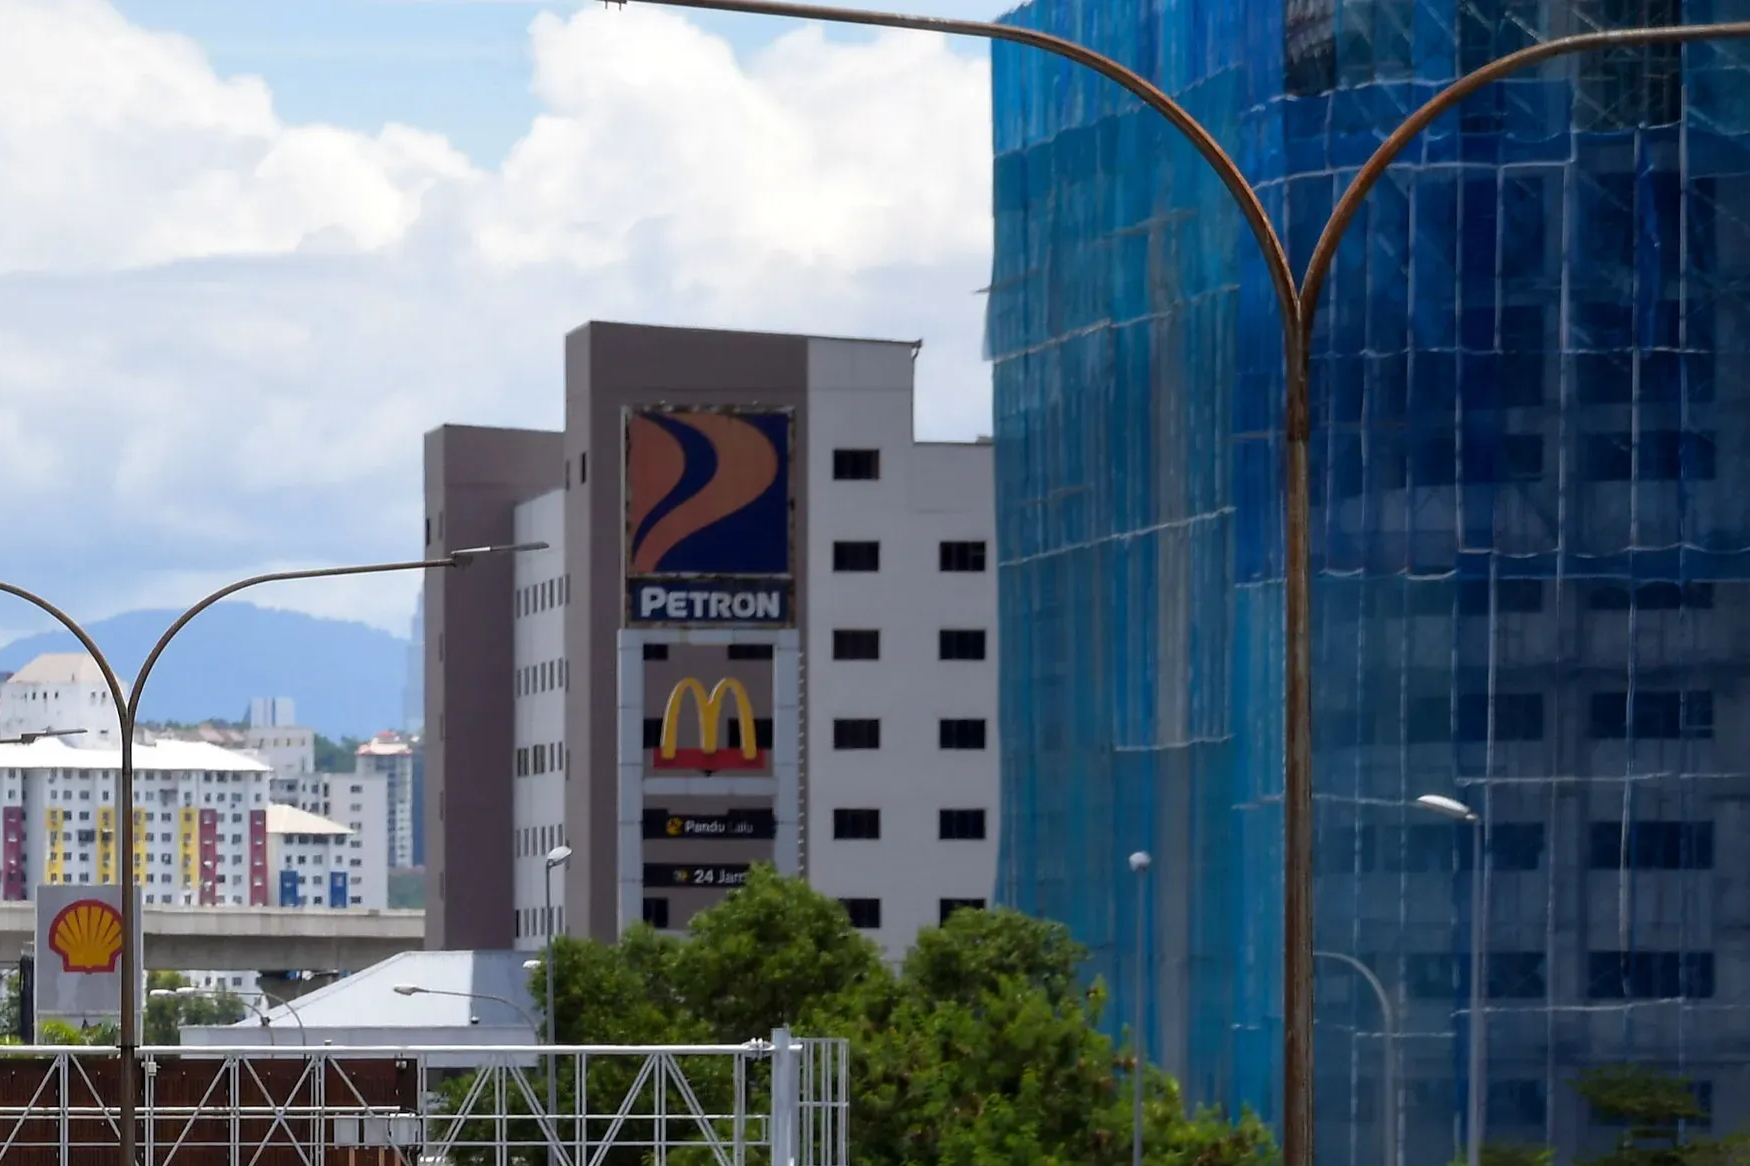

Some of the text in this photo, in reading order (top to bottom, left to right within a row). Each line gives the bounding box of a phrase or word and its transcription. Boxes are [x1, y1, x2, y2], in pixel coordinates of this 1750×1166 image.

[641, 587, 780, 618] PETRON
[685, 820, 725, 833] Pandu
[694, 869, 714, 884] 24
